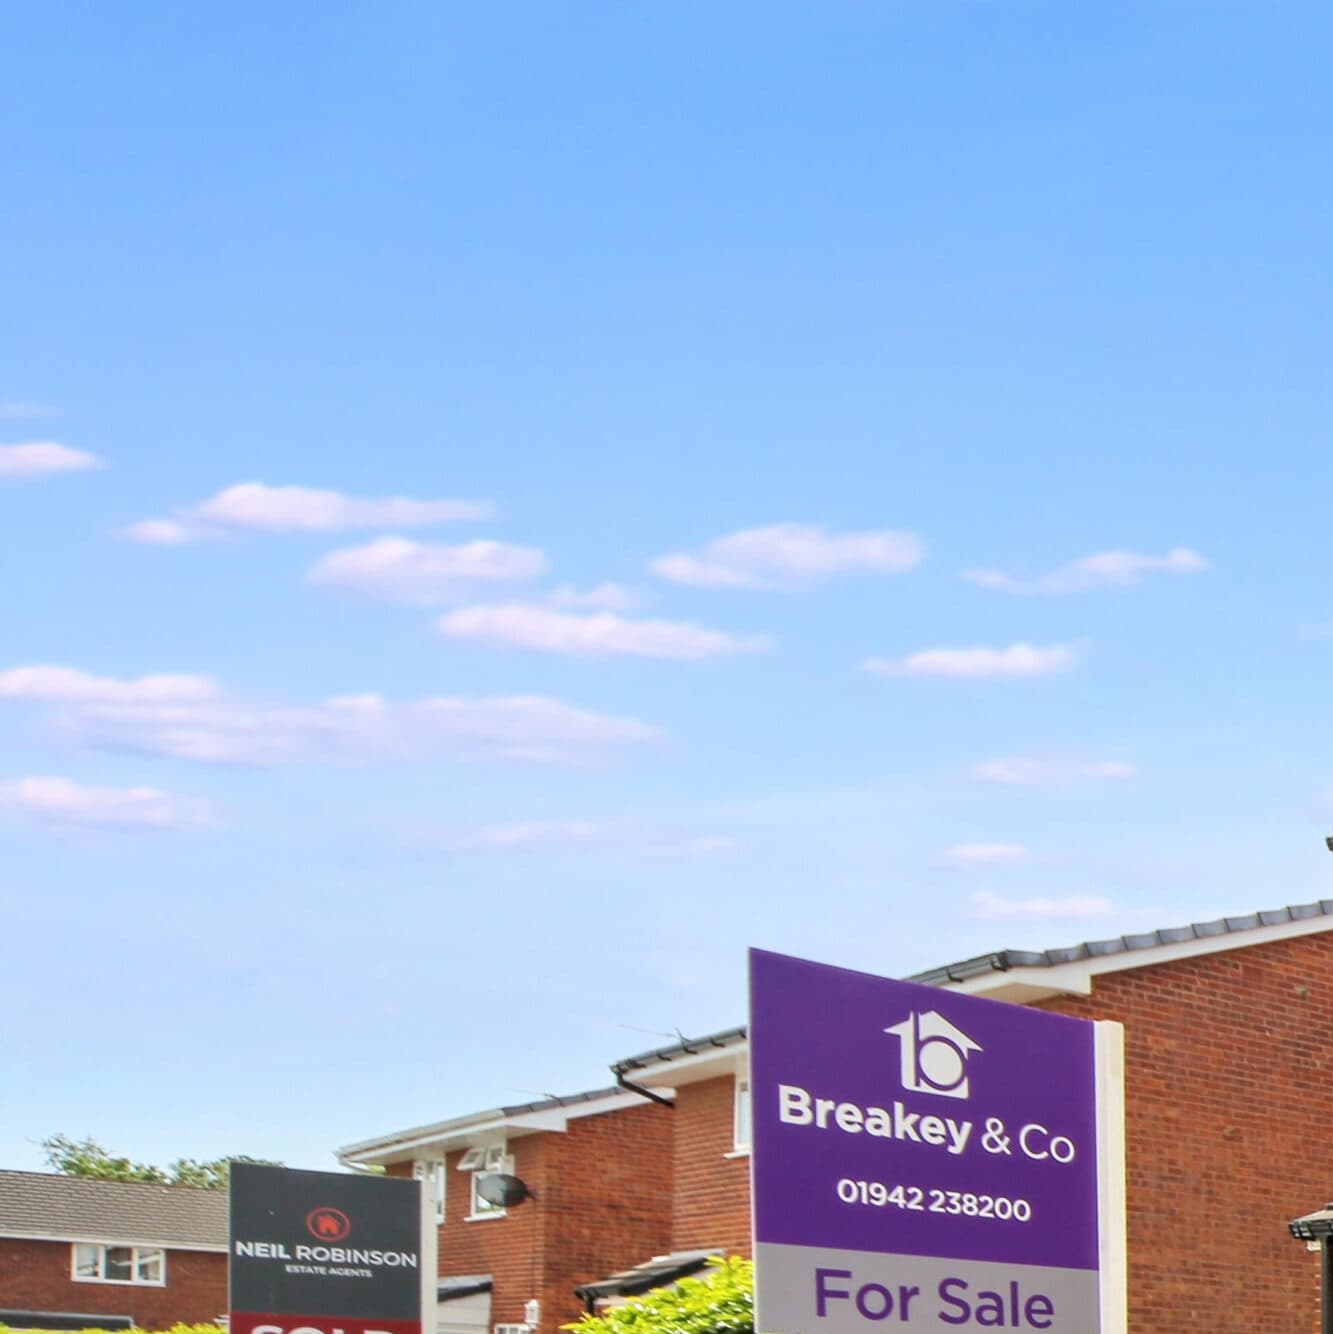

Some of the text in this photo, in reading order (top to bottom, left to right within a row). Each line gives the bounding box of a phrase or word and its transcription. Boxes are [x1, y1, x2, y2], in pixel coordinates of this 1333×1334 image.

[778, 1084, 1075, 1163] Breakey & Co
[837, 1179, 1031, 1222] 01942 238200
[235, 1241, 417, 1268] NEIL ROBINSON
[285, 1264, 373, 1278] ESTATE AGENTS
[815, 1268, 1055, 1329] For Sale
